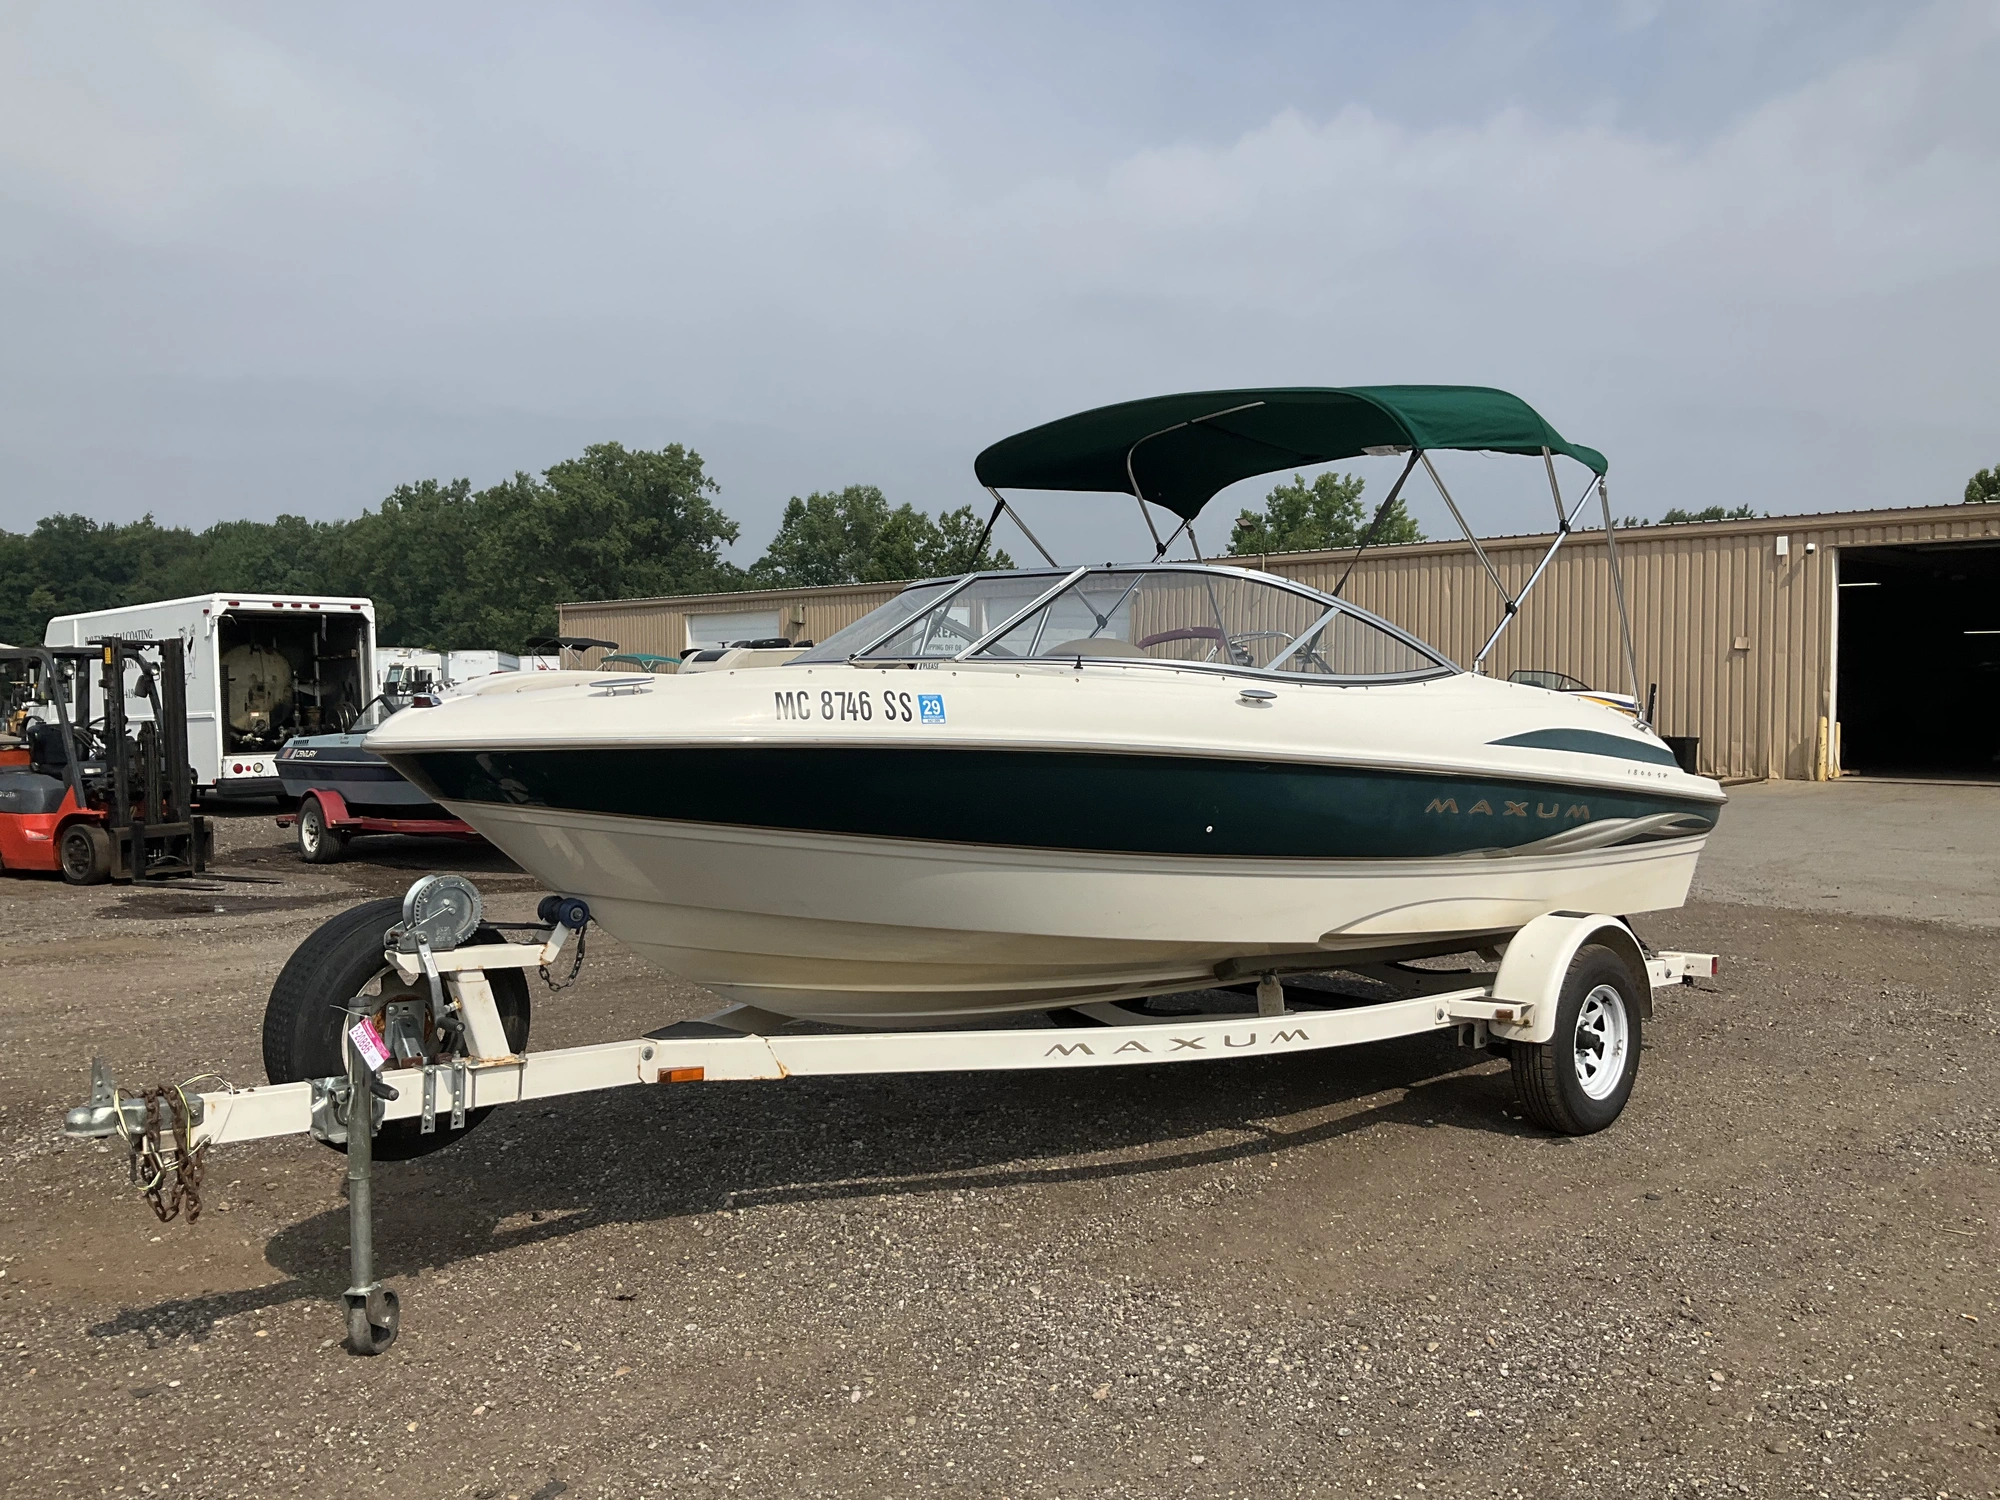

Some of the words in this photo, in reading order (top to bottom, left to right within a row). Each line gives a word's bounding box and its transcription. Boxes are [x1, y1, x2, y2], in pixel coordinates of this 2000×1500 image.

[775, 691, 811, 720] MC
[821, 691, 873, 721] 8746
[883, 690, 913, 722] SS
[922, 700, 941, 715] 29
[1424, 798, 1591, 820] MAXUM
[1044, 1028, 1310, 1057] MAXUM
